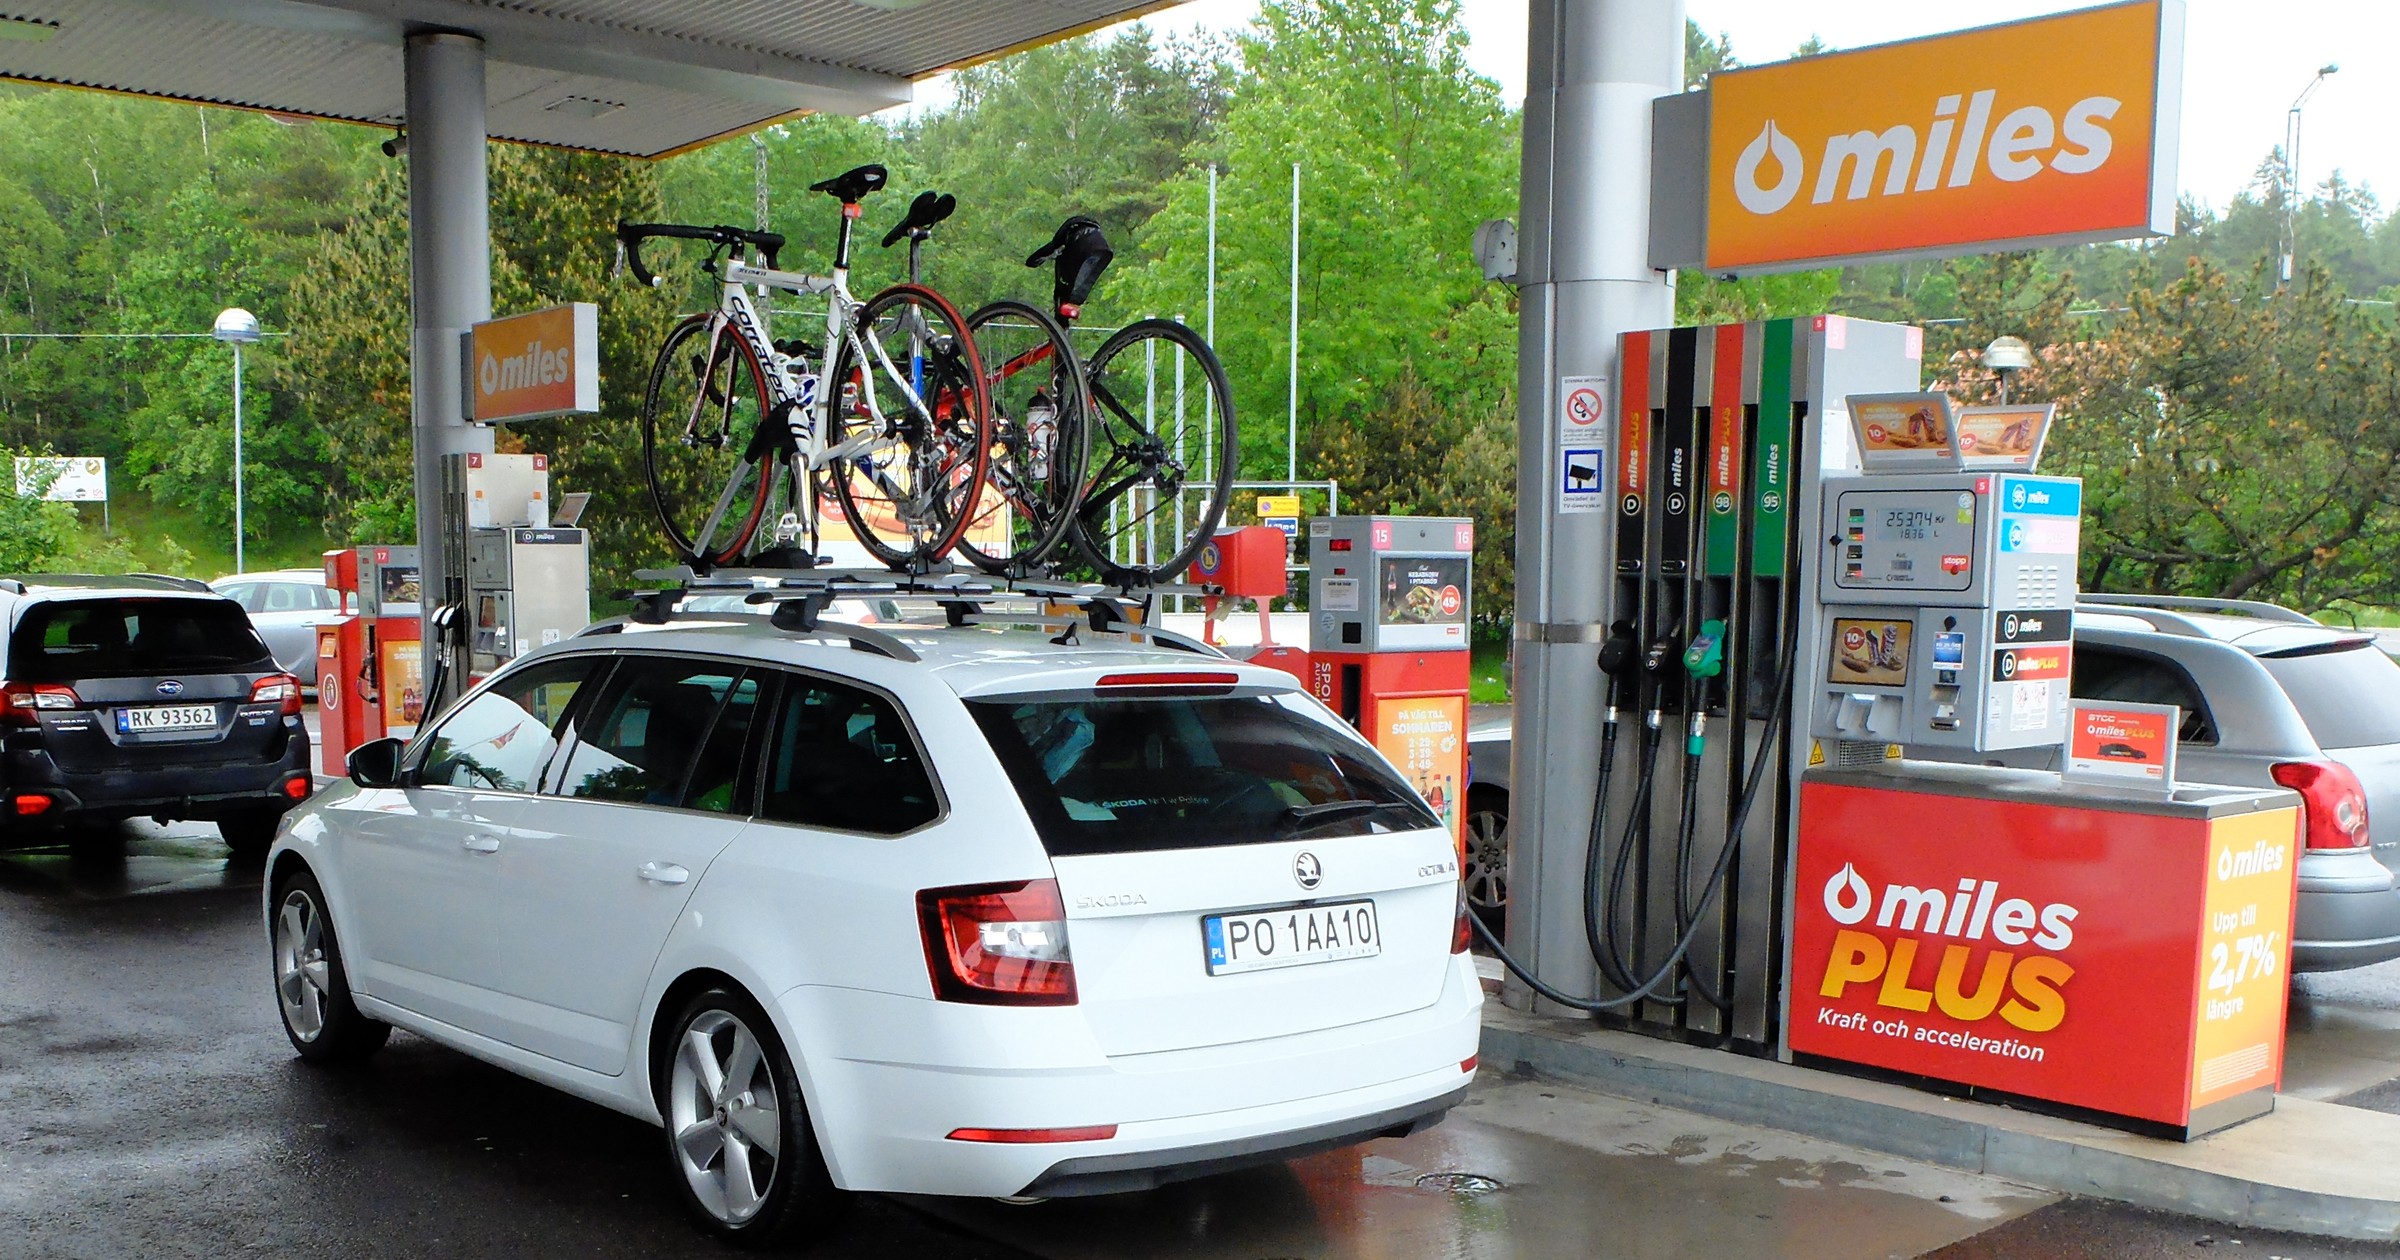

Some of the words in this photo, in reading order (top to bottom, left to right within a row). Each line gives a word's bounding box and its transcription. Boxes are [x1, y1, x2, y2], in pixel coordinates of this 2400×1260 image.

[1812, 89, 2122, 205] miles
[1816, 320, 1822, 328] 5
[1831, 327, 1839, 341] 5
[1909, 336, 1917, 350] 6
[500, 340, 569, 391] miles
[472, 456, 478, 465] 7
[537, 458, 543, 467] 8
[1671, 447, 1683, 487] miles
[1766, 443, 1779, 485] miles
[1979, 482, 1986, 490] 5
[1626, 498, 1637, 510] D
[1670, 498, 1682, 510] D
[1715, 496, 1731, 509] 98
[1763, 496, 1779, 509] 95
[2027, 491, 2050, 504] miles
[1376, 530, 1388, 543] 15
[1457, 531, 1469, 544] 16
[377, 552, 387, 560] 17
[1944, 556, 1967, 566] stopp
[2008, 620, 2015, 633] D
[2019, 619, 2043, 632] miles
[2006, 658, 2013, 671] D
[2017, 656, 2059, 670] milesPLUS
[132, 710, 154, 726] RK
[162, 708, 213, 726] 93562
[1428, 709, 1445, 719] TILL
[1391, 720, 1453, 735] SOMMAREN
[2095, 725, 2155, 739] milesPLUS
[2232, 840, 2285, 878] miles
[1876, 877, 2079, 951] miles
[2212, 911, 2238, 935] Upp
[2241, 904, 2257, 926] till
[1228, 918, 1275, 960] PO
[1288, 908, 1372, 952] 1AA10
[1211, 948, 1225, 960] PL
[1819, 929, 2076, 1032] PLUS
[2206, 996, 2244, 1021] längre
[1817, 1007, 1868, 1032] Kraft
[1872, 1020, 1909, 1039] och
[1914, 1026, 2045, 1062] acceleration
